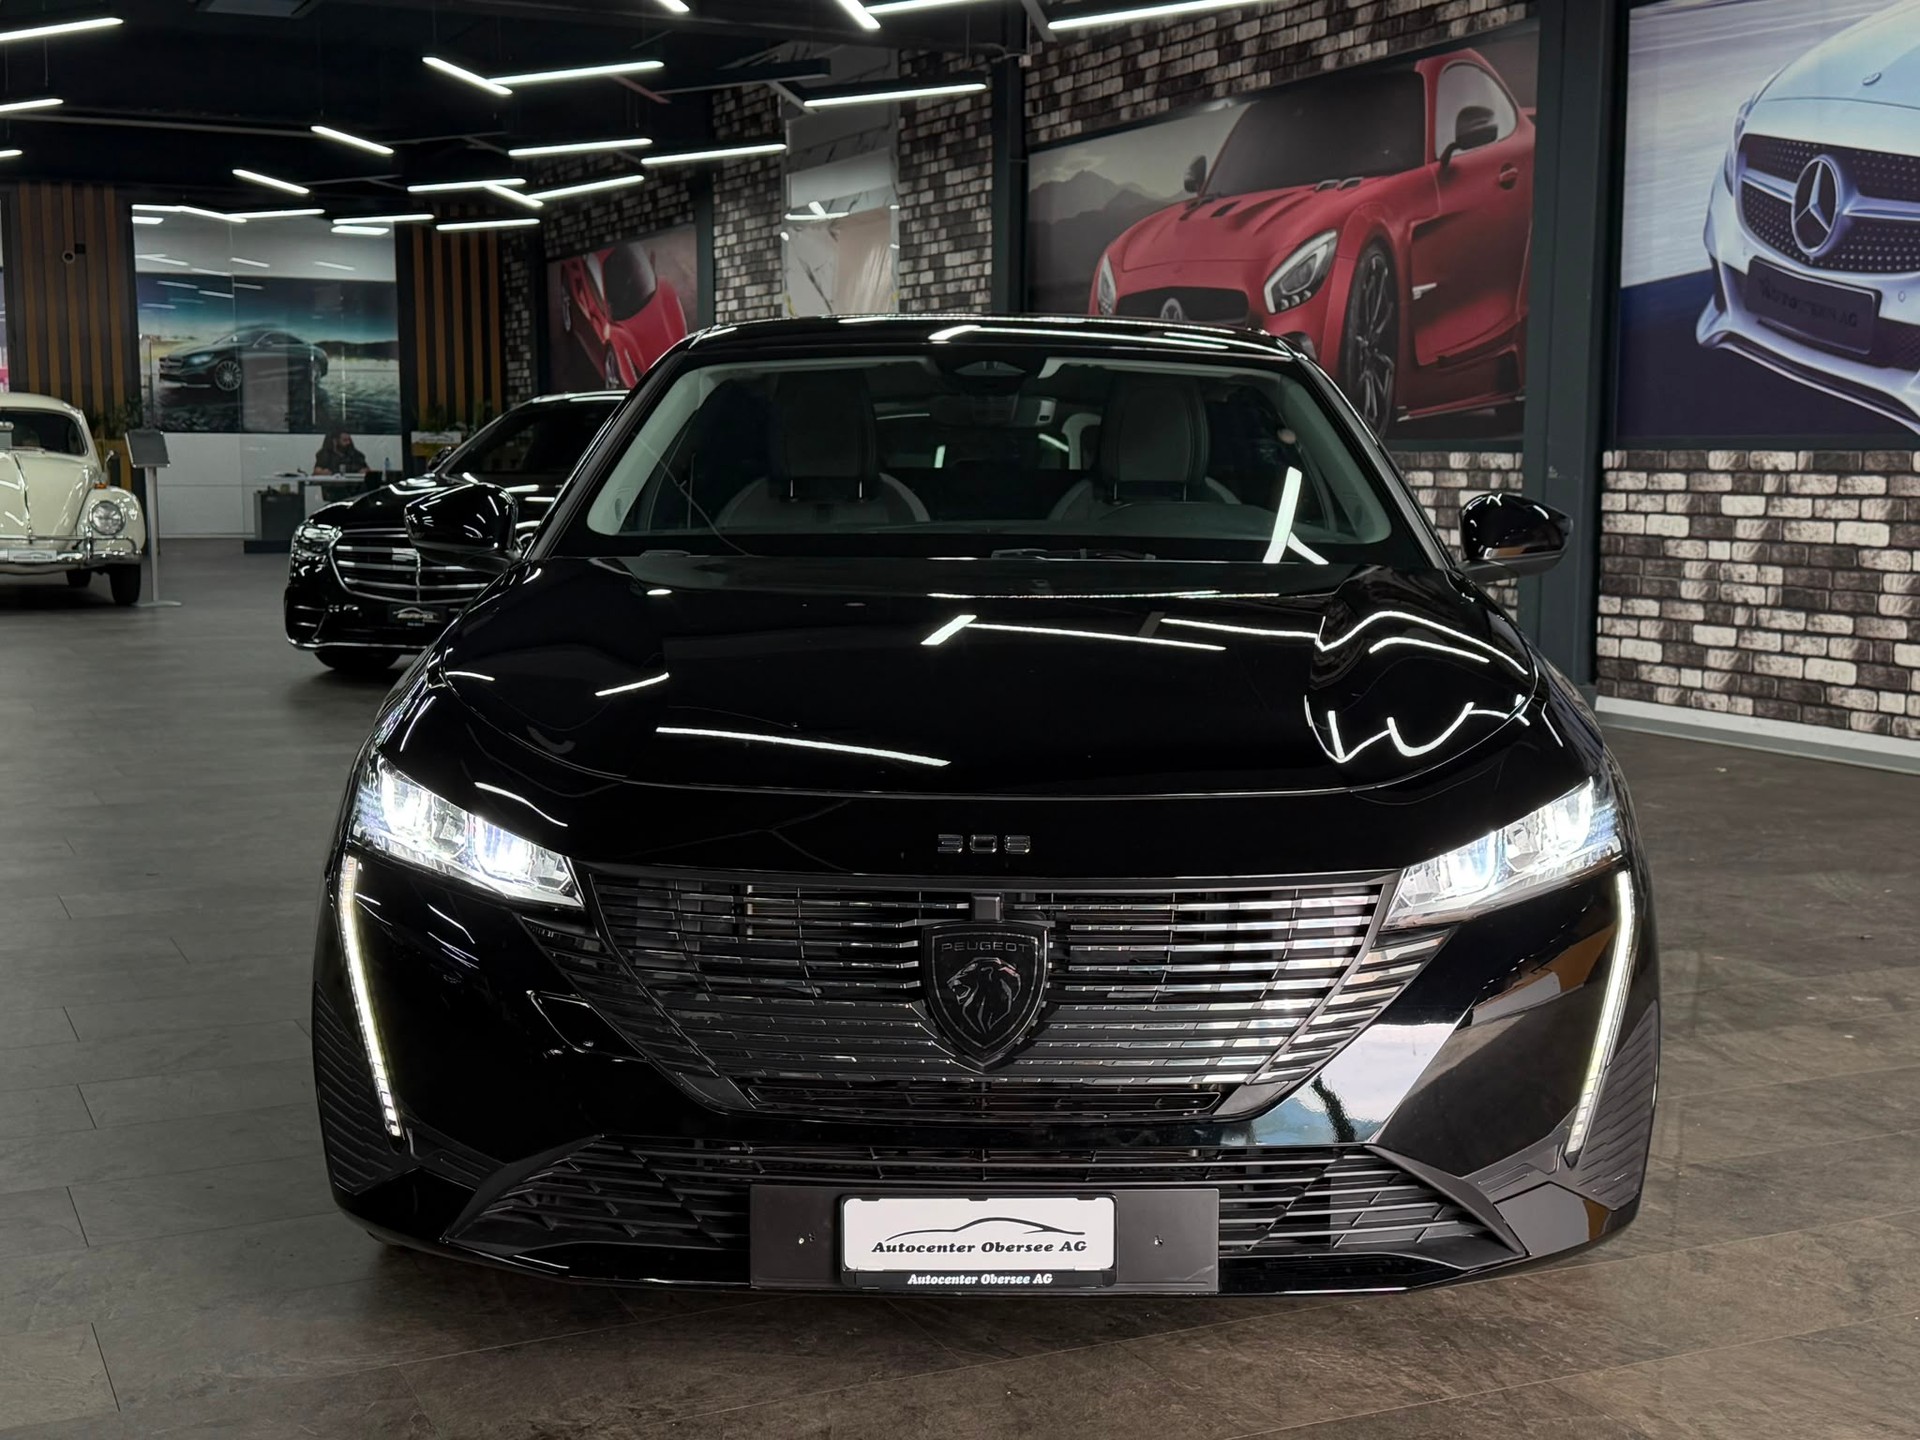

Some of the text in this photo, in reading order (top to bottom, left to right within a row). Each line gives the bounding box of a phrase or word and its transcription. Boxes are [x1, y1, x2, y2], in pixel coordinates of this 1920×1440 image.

[937, 834, 1031, 854] 308
[941, 941, 1030, 953] PEUGEOT
[871, 1240, 1087, 1253] Autocenter Obersee AG
[907, 1272, 1053, 1285] Autocenter Obersee AG
